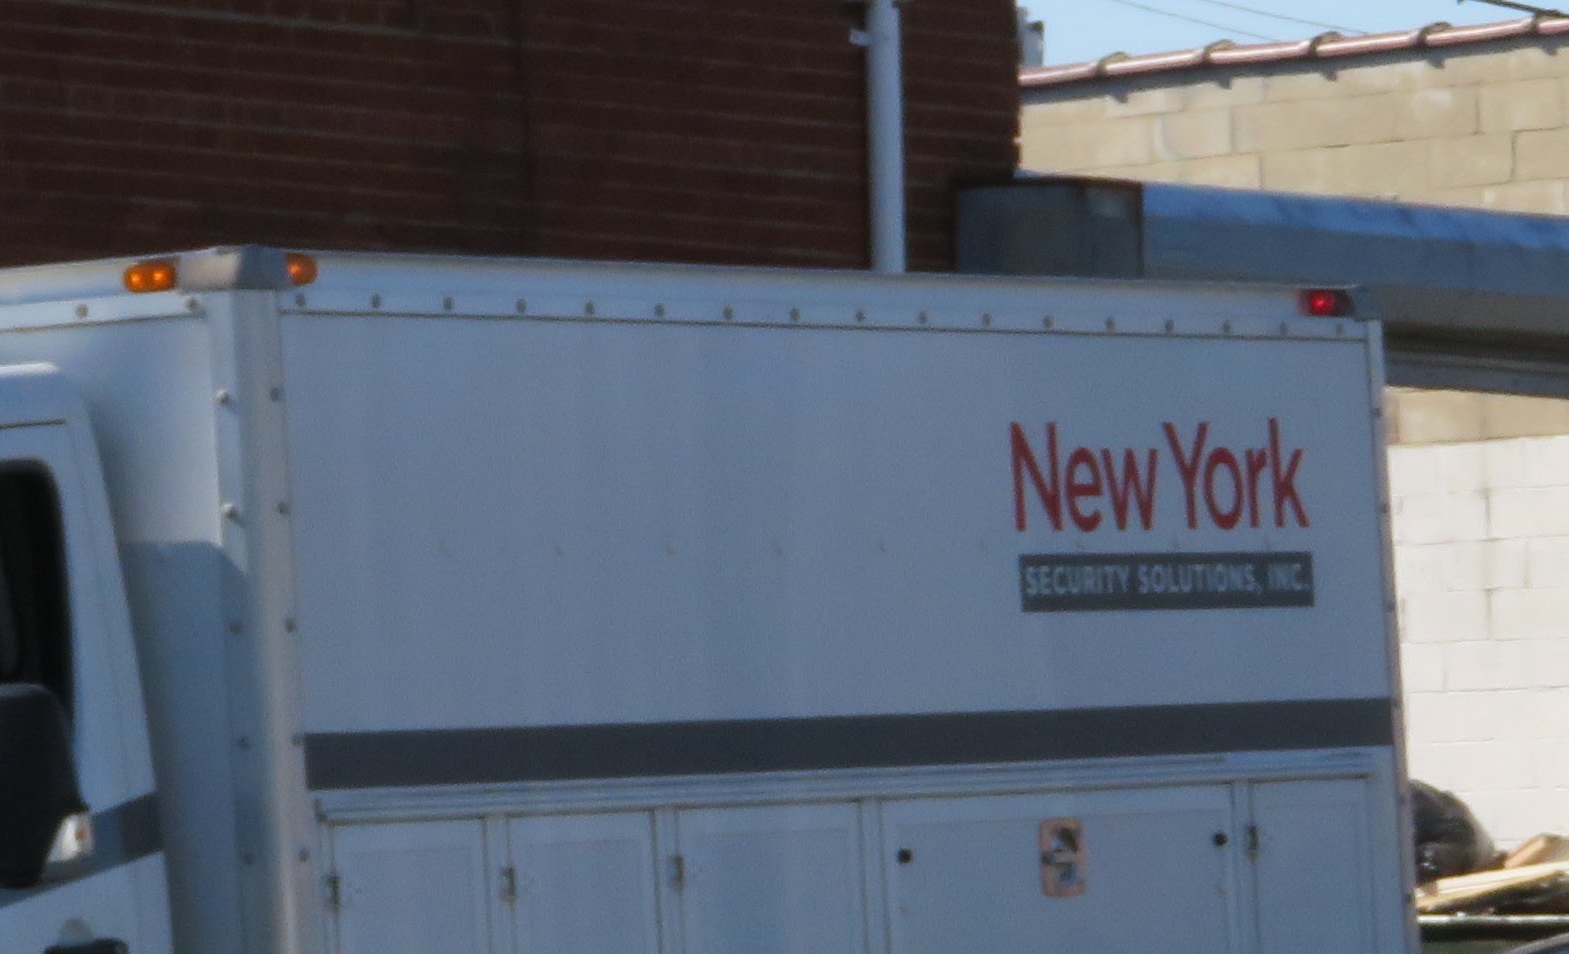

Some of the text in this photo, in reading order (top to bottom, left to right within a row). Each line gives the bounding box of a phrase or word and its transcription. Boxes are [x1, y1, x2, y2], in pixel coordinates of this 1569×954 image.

[1026, 561, 1311, 597] SECURITY SOLUTIONS, INC.
